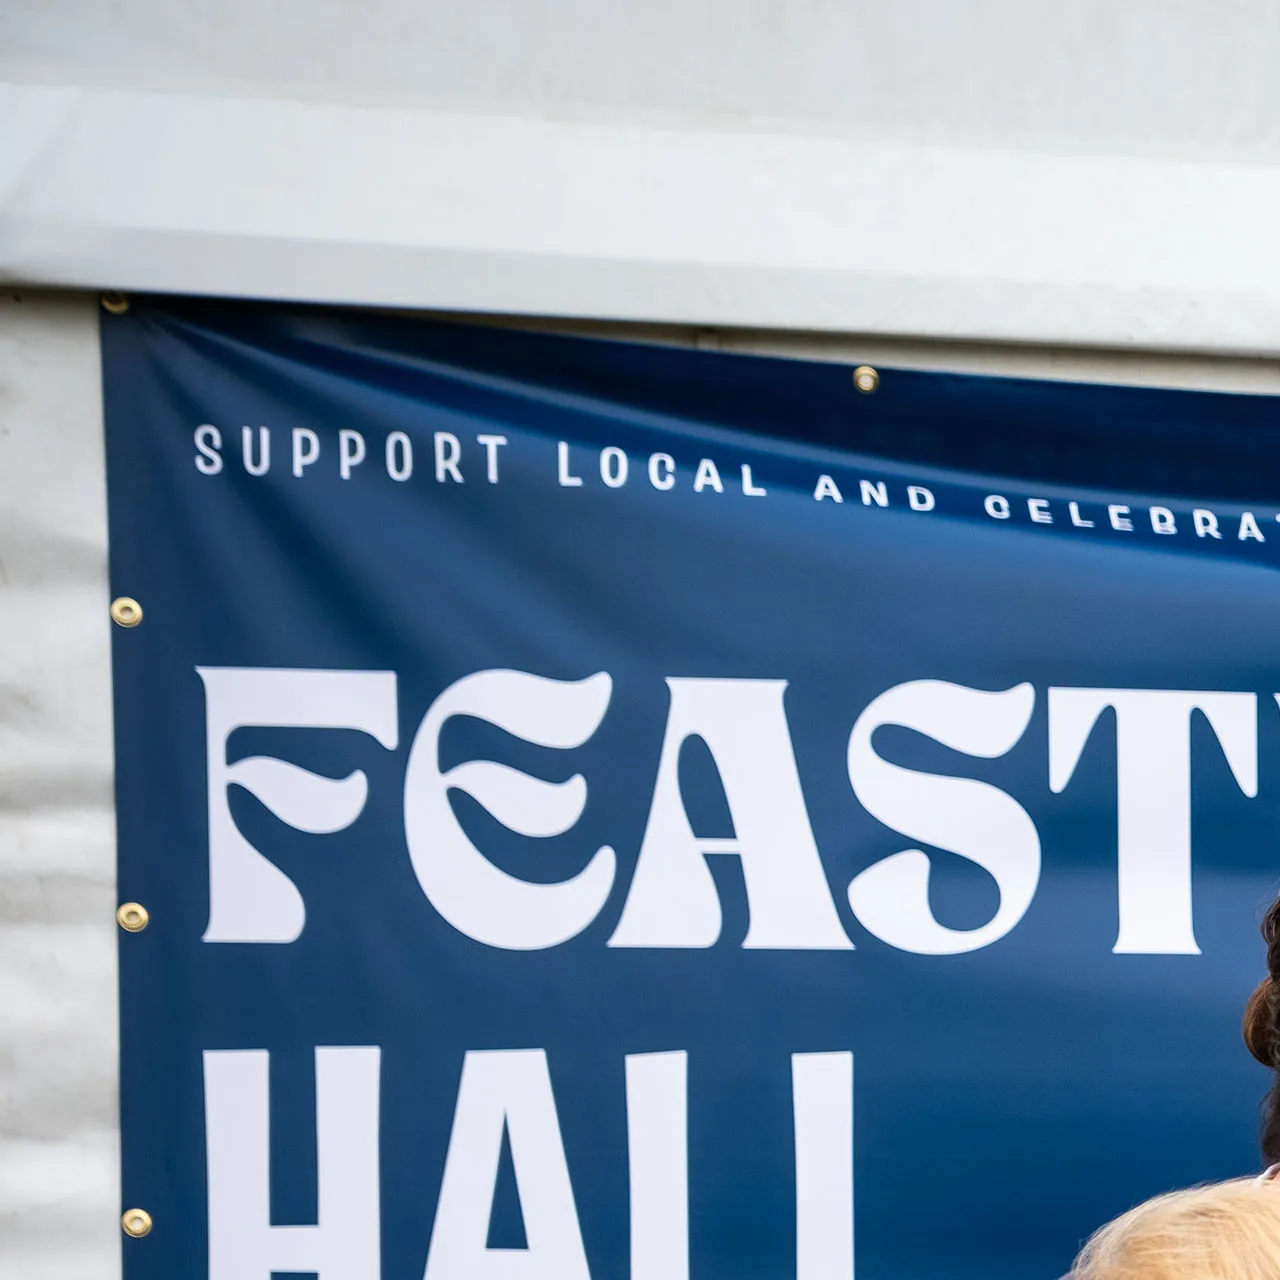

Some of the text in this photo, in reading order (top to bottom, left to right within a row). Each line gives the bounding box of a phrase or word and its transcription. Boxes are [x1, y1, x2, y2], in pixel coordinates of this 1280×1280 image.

[193, 424, 508, 484] SUPPORT
[557, 440, 768, 498] LOCAL
[813, 474, 936, 512] AND
